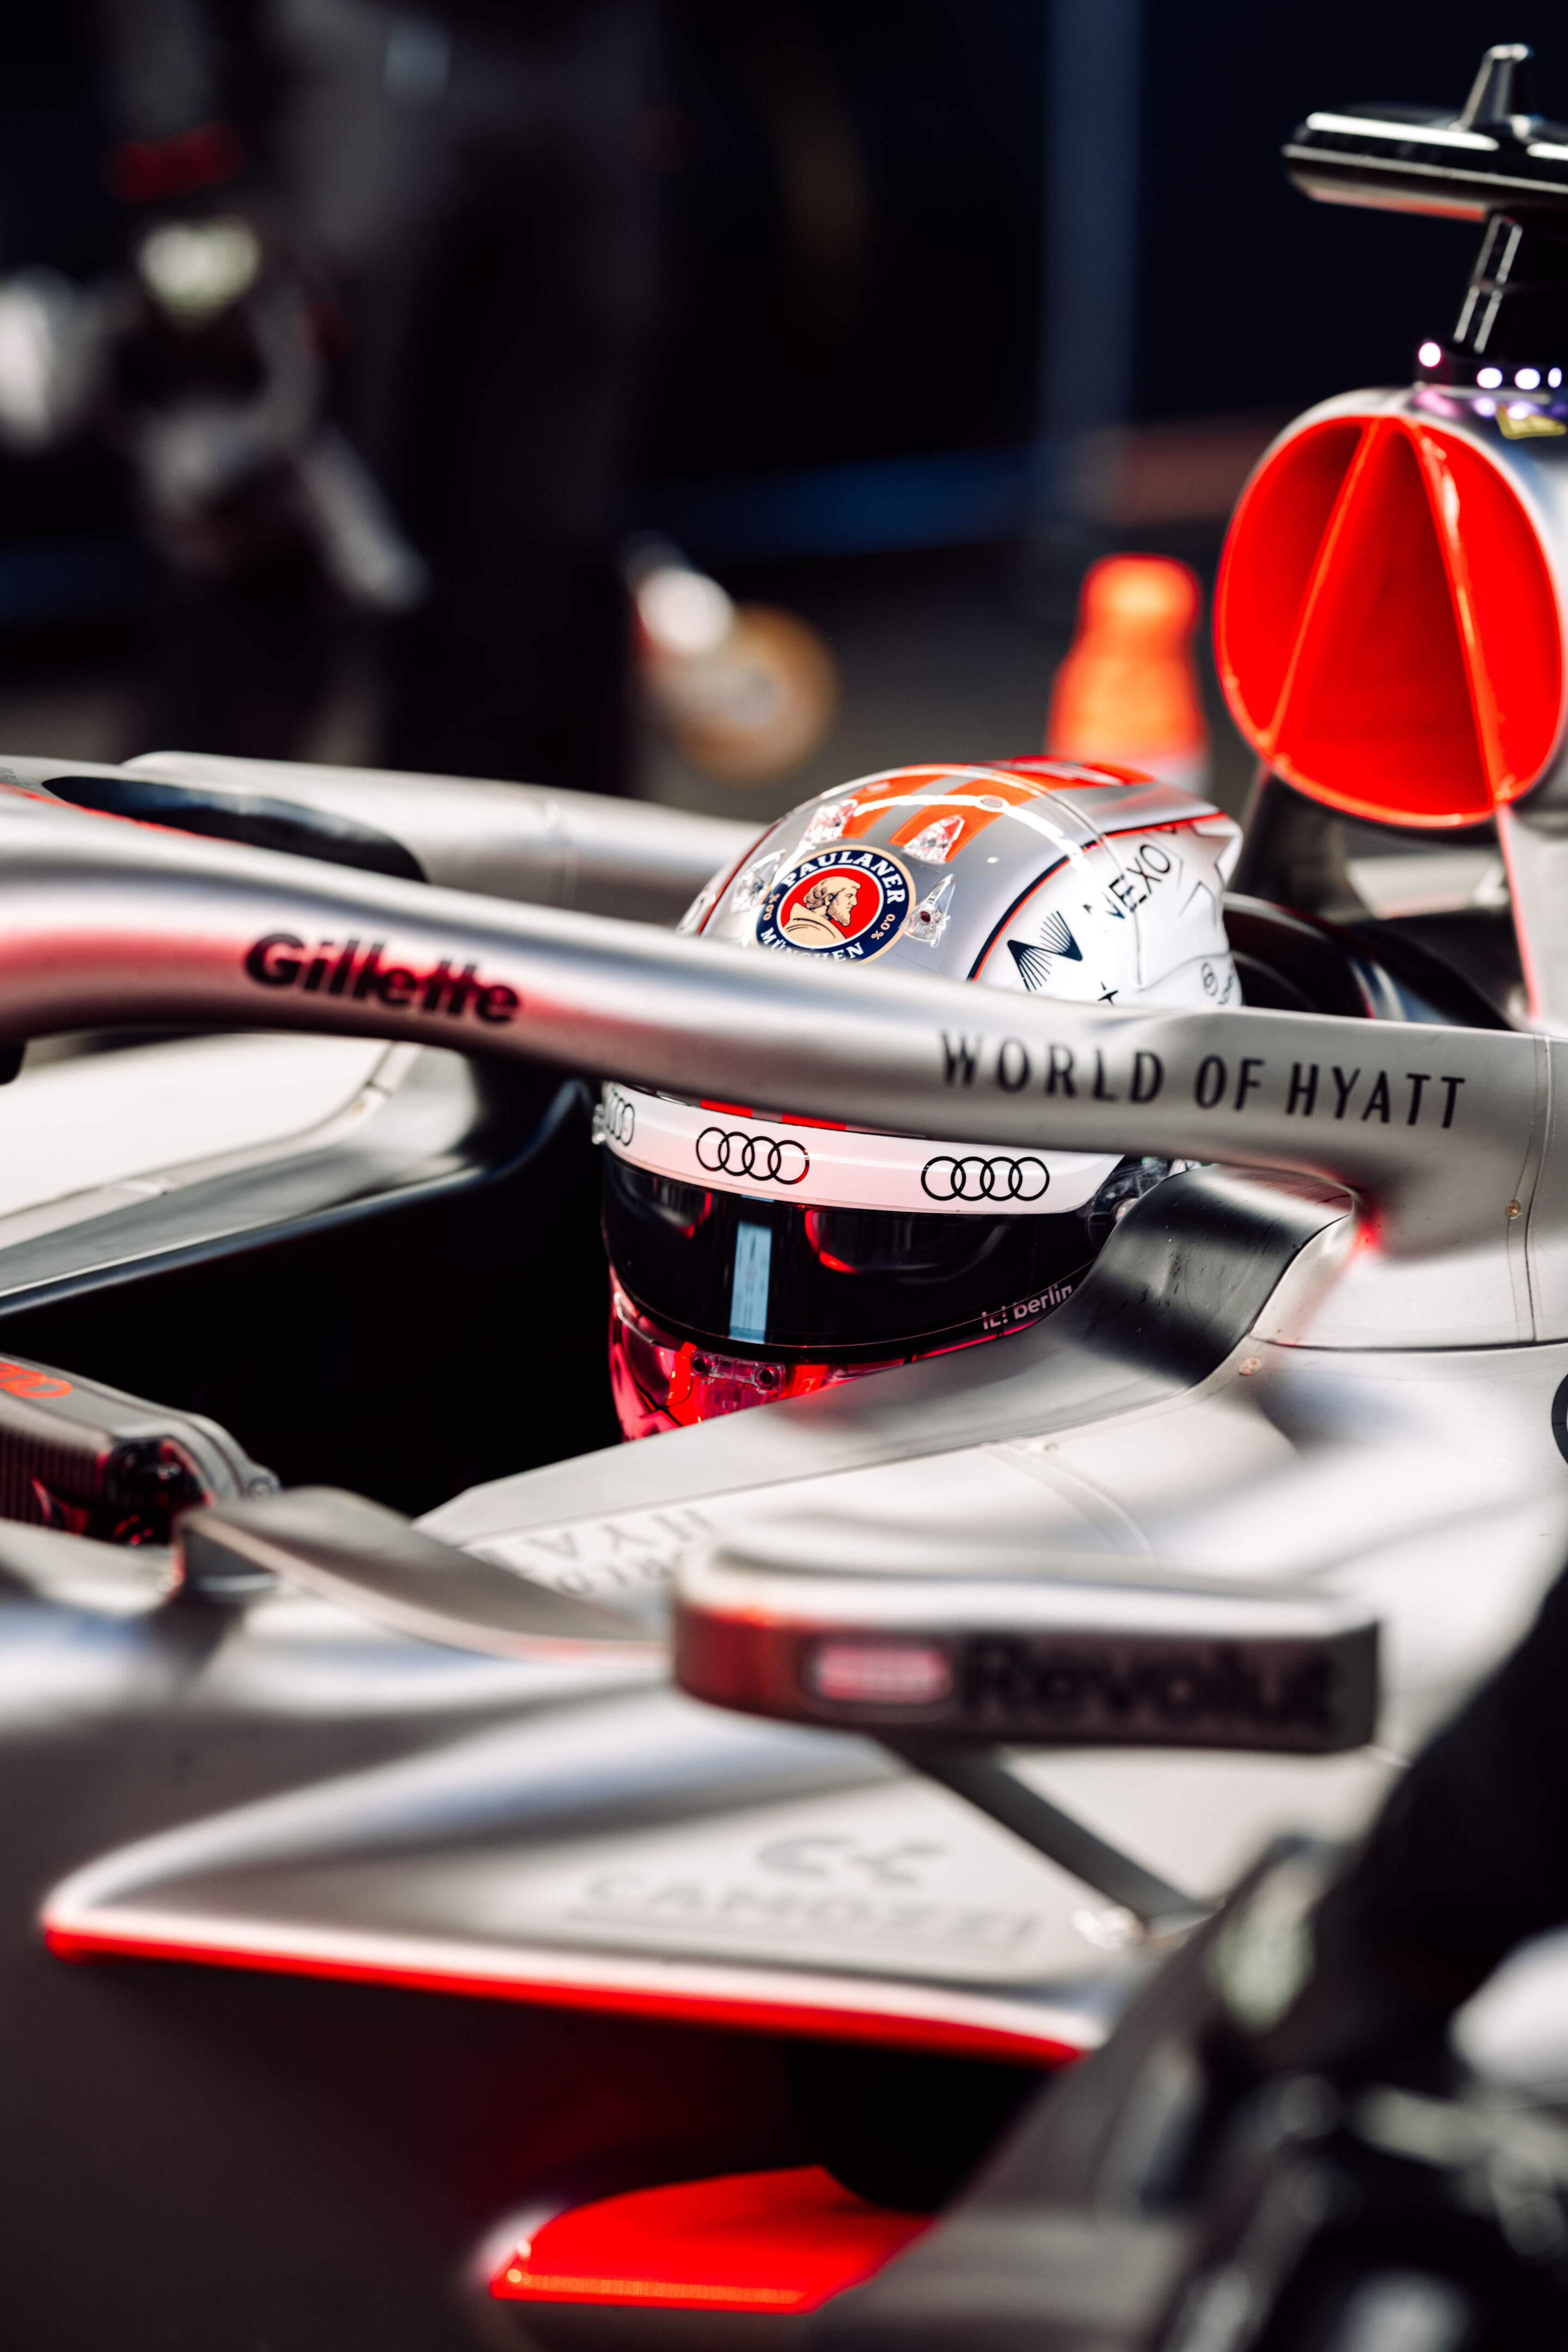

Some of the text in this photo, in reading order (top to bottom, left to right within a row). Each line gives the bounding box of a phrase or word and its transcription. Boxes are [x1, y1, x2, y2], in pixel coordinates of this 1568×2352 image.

[781, 851, 906, 904] PAULANER
[245, 933, 519, 1024] Gillette
[941, 1026, 1466, 1129] WORLD OF HYATT
[1012, 1283, 1073, 1320] berlin
